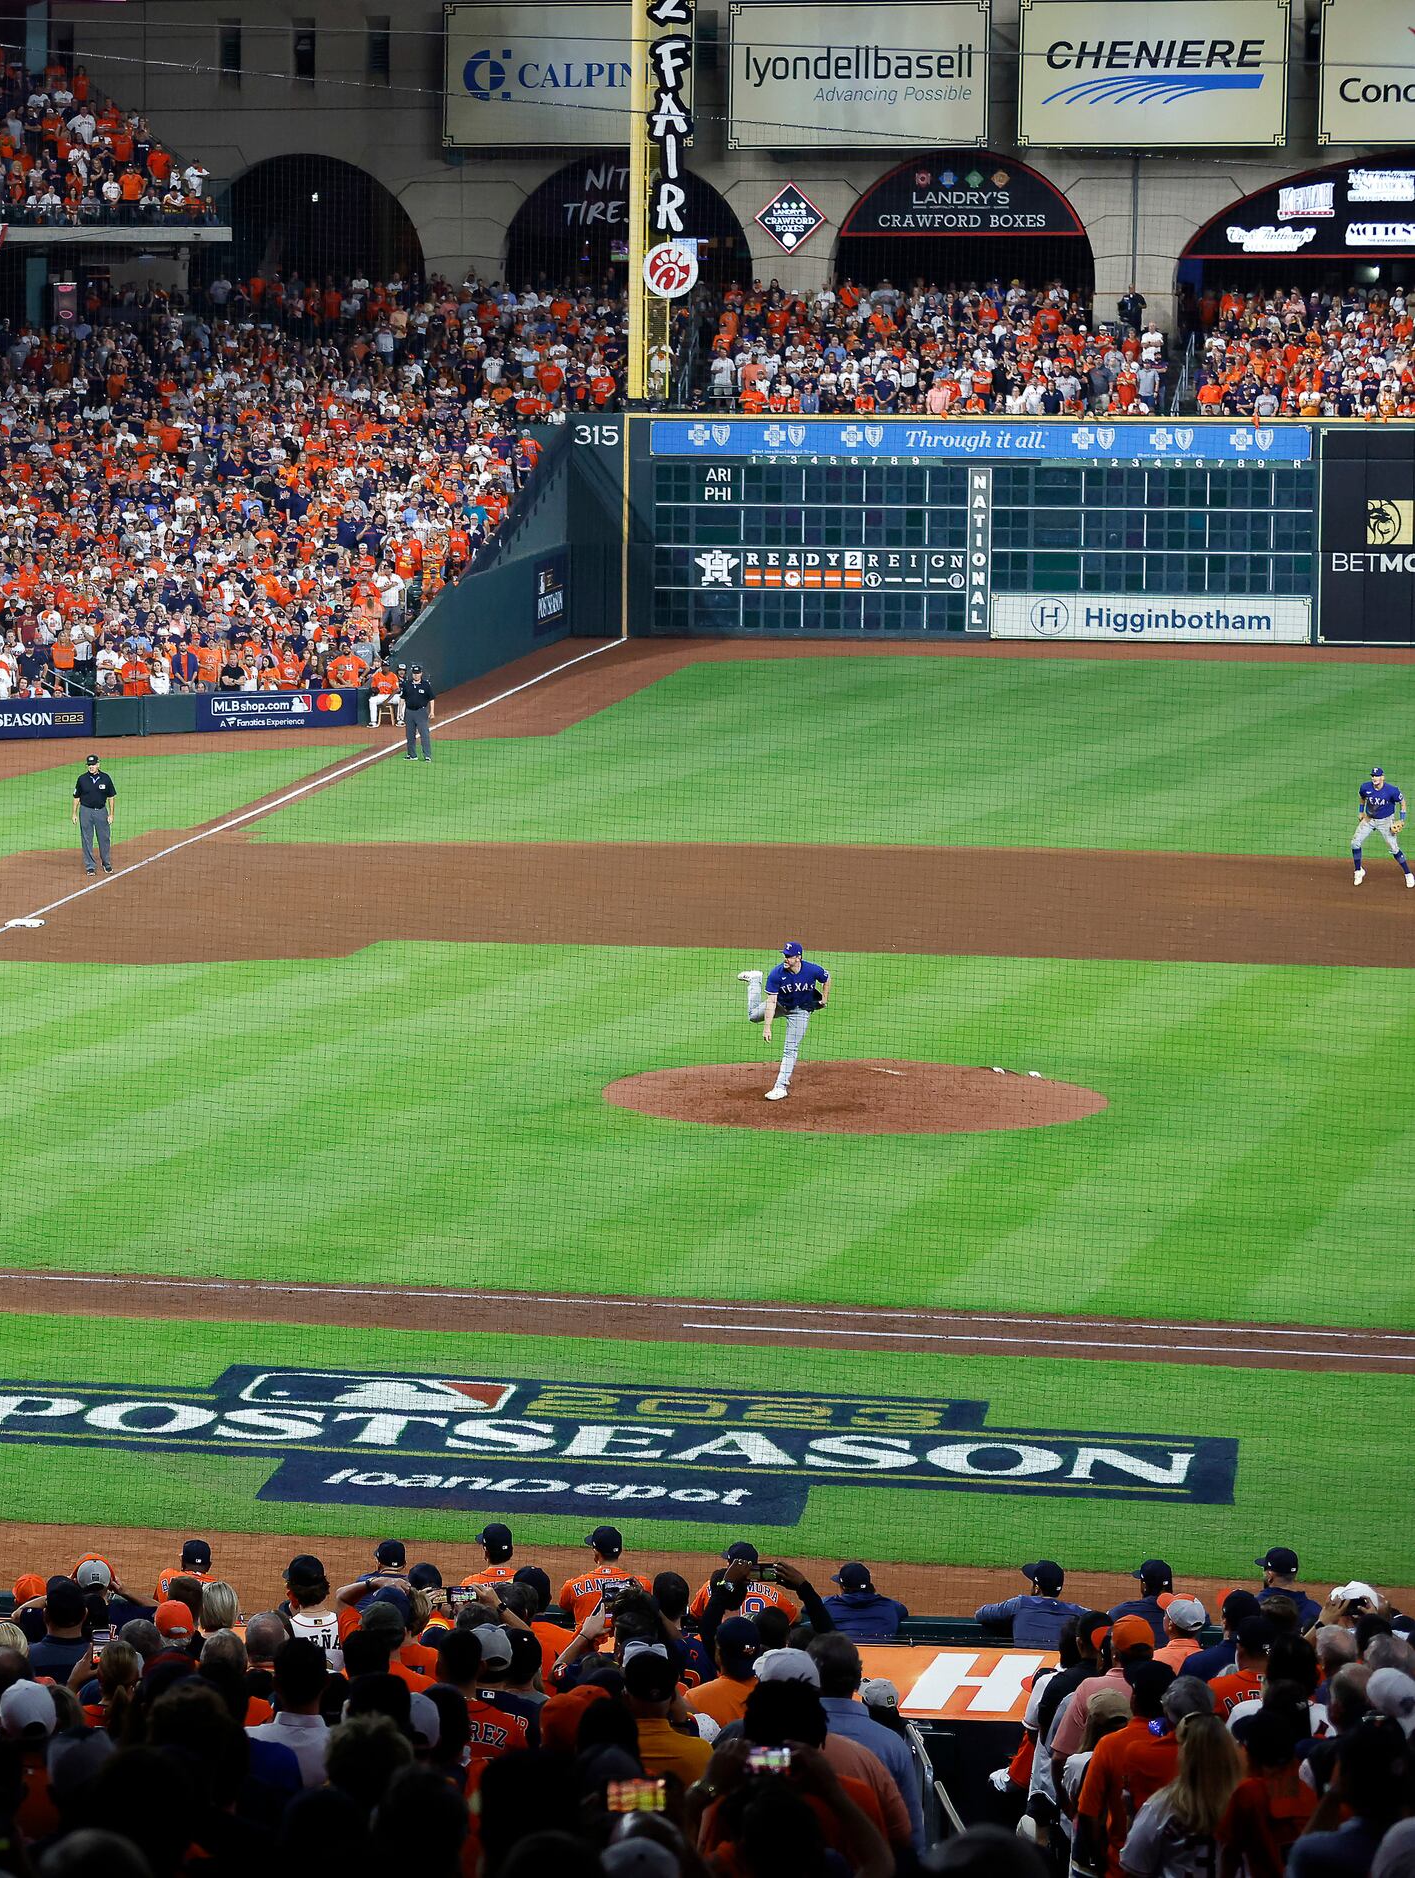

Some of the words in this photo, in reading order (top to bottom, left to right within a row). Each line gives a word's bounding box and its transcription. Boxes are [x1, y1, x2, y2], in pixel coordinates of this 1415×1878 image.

[1046, 39, 1265, 69] CHENIERE
[745, 43, 972, 88] lyondellbasell
[813, 86, 898, 104] Advancing
[903, 85, 972, 101] Possible
[652, 41, 687, 232] FAIR
[912, 191, 1010, 205] LANDRY'S
[764, 217, 816, 225] CRAWFORD
[878, 214, 981, 228] CRAWFORD
[989, 214, 1046, 228] BOXES
[573, 425, 619, 446] 315
[905, 429, 991, 453] Through
[996, 430, 1012, 449] it
[706, 467, 732, 482] ARI
[704, 486, 732, 501] PHI
[970, 475, 987, 626] NATIONAL
[1085, 607, 1271, 633] Higginbotham
[213, 699, 290, 714] MLBshop.com
[54, 714, 84, 723] 2023
[236, 718, 266, 727] Fanatics
[266, 717, 305, 727] Experience
[524, 1390, 945, 1428] 2023
[321, 1467, 753, 1506] loanDepot
